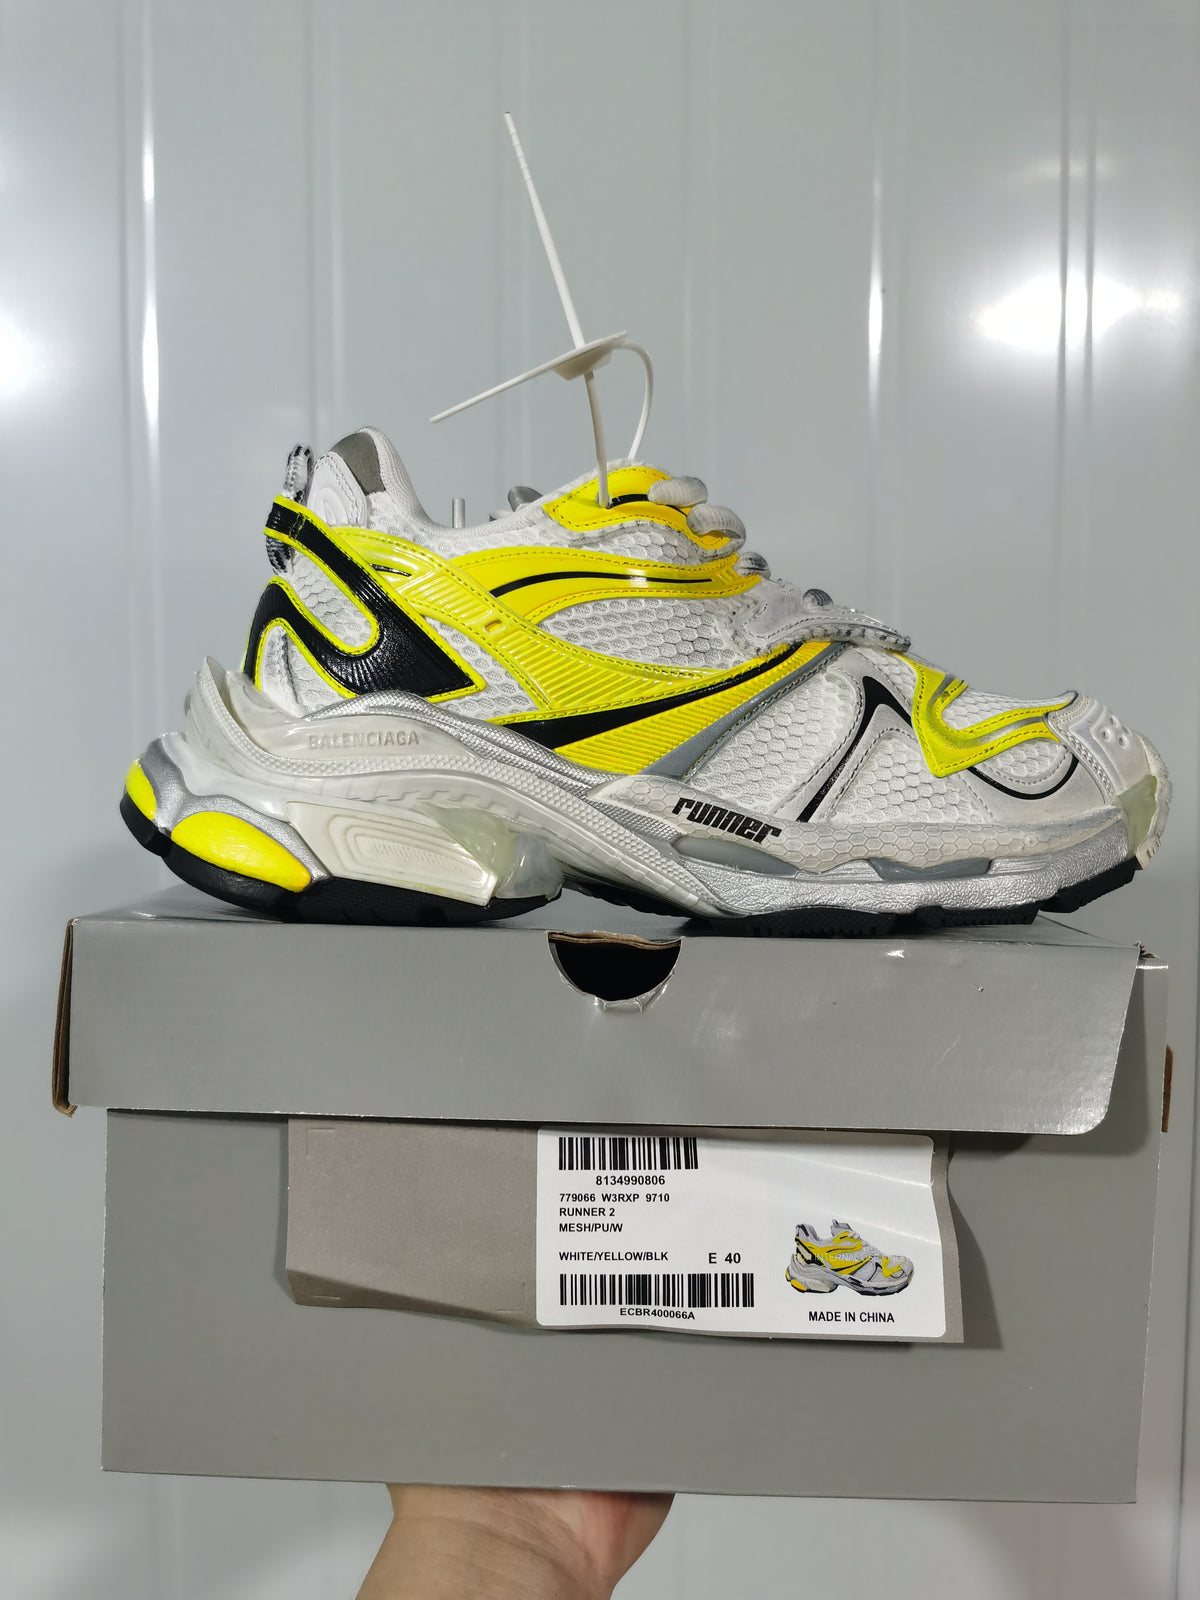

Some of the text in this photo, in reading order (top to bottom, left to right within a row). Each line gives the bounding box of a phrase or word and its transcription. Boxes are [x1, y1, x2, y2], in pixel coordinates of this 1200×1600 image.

[308, 730, 420, 750] BALENCIAGA
[672, 797, 782, 844] runner
[595, 1175, 666, 1186] 8134990806
[559, 1193, 670, 1203] 779066 W3RXP 9710
[559, 1207, 616, 1217] RUNNER 2
[559, 1223, 624, 1233] MESH/PU/W
[559, 1251, 669, 1261] WHITE/YELLOW/BLK
[708, 1252, 742, 1264] E 40
[619, 1307, 696, 1320] ECBR400066A
[808, 1311, 895, 1322] MADE IN CHINA
